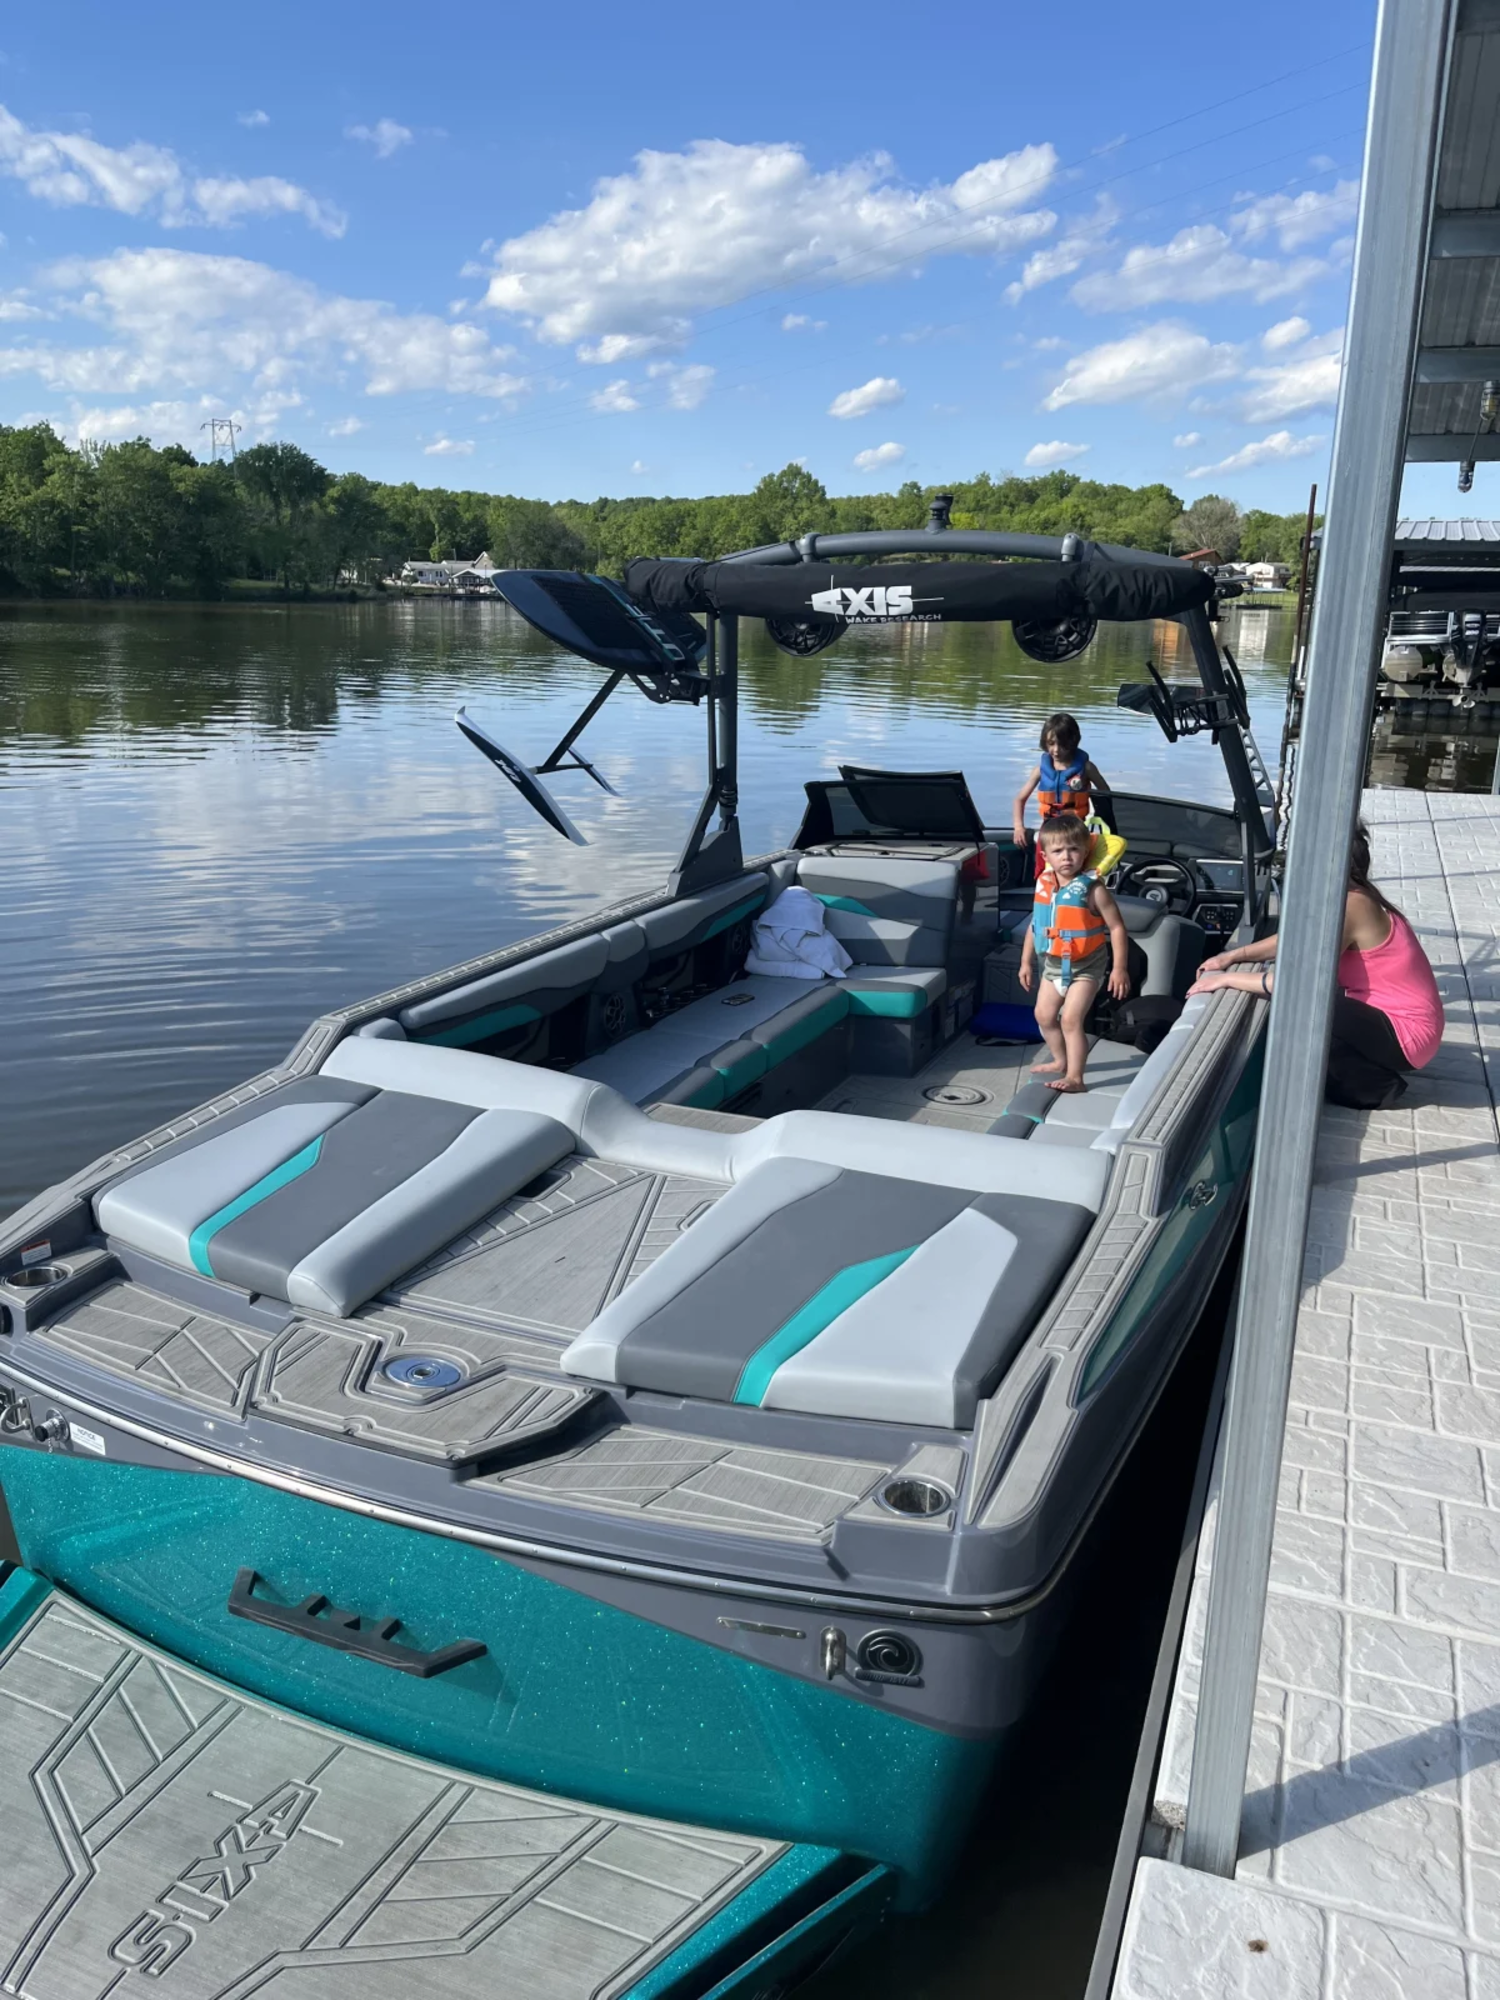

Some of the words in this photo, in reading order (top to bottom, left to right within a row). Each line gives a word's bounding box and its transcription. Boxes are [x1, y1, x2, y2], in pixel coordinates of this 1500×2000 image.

[811, 586, 914, 616] AXIS
[845, 616, 877, 625] WAKE
[880, 613, 942, 625] RESEARCH
[107, 1778, 322, 1977] AXIS
